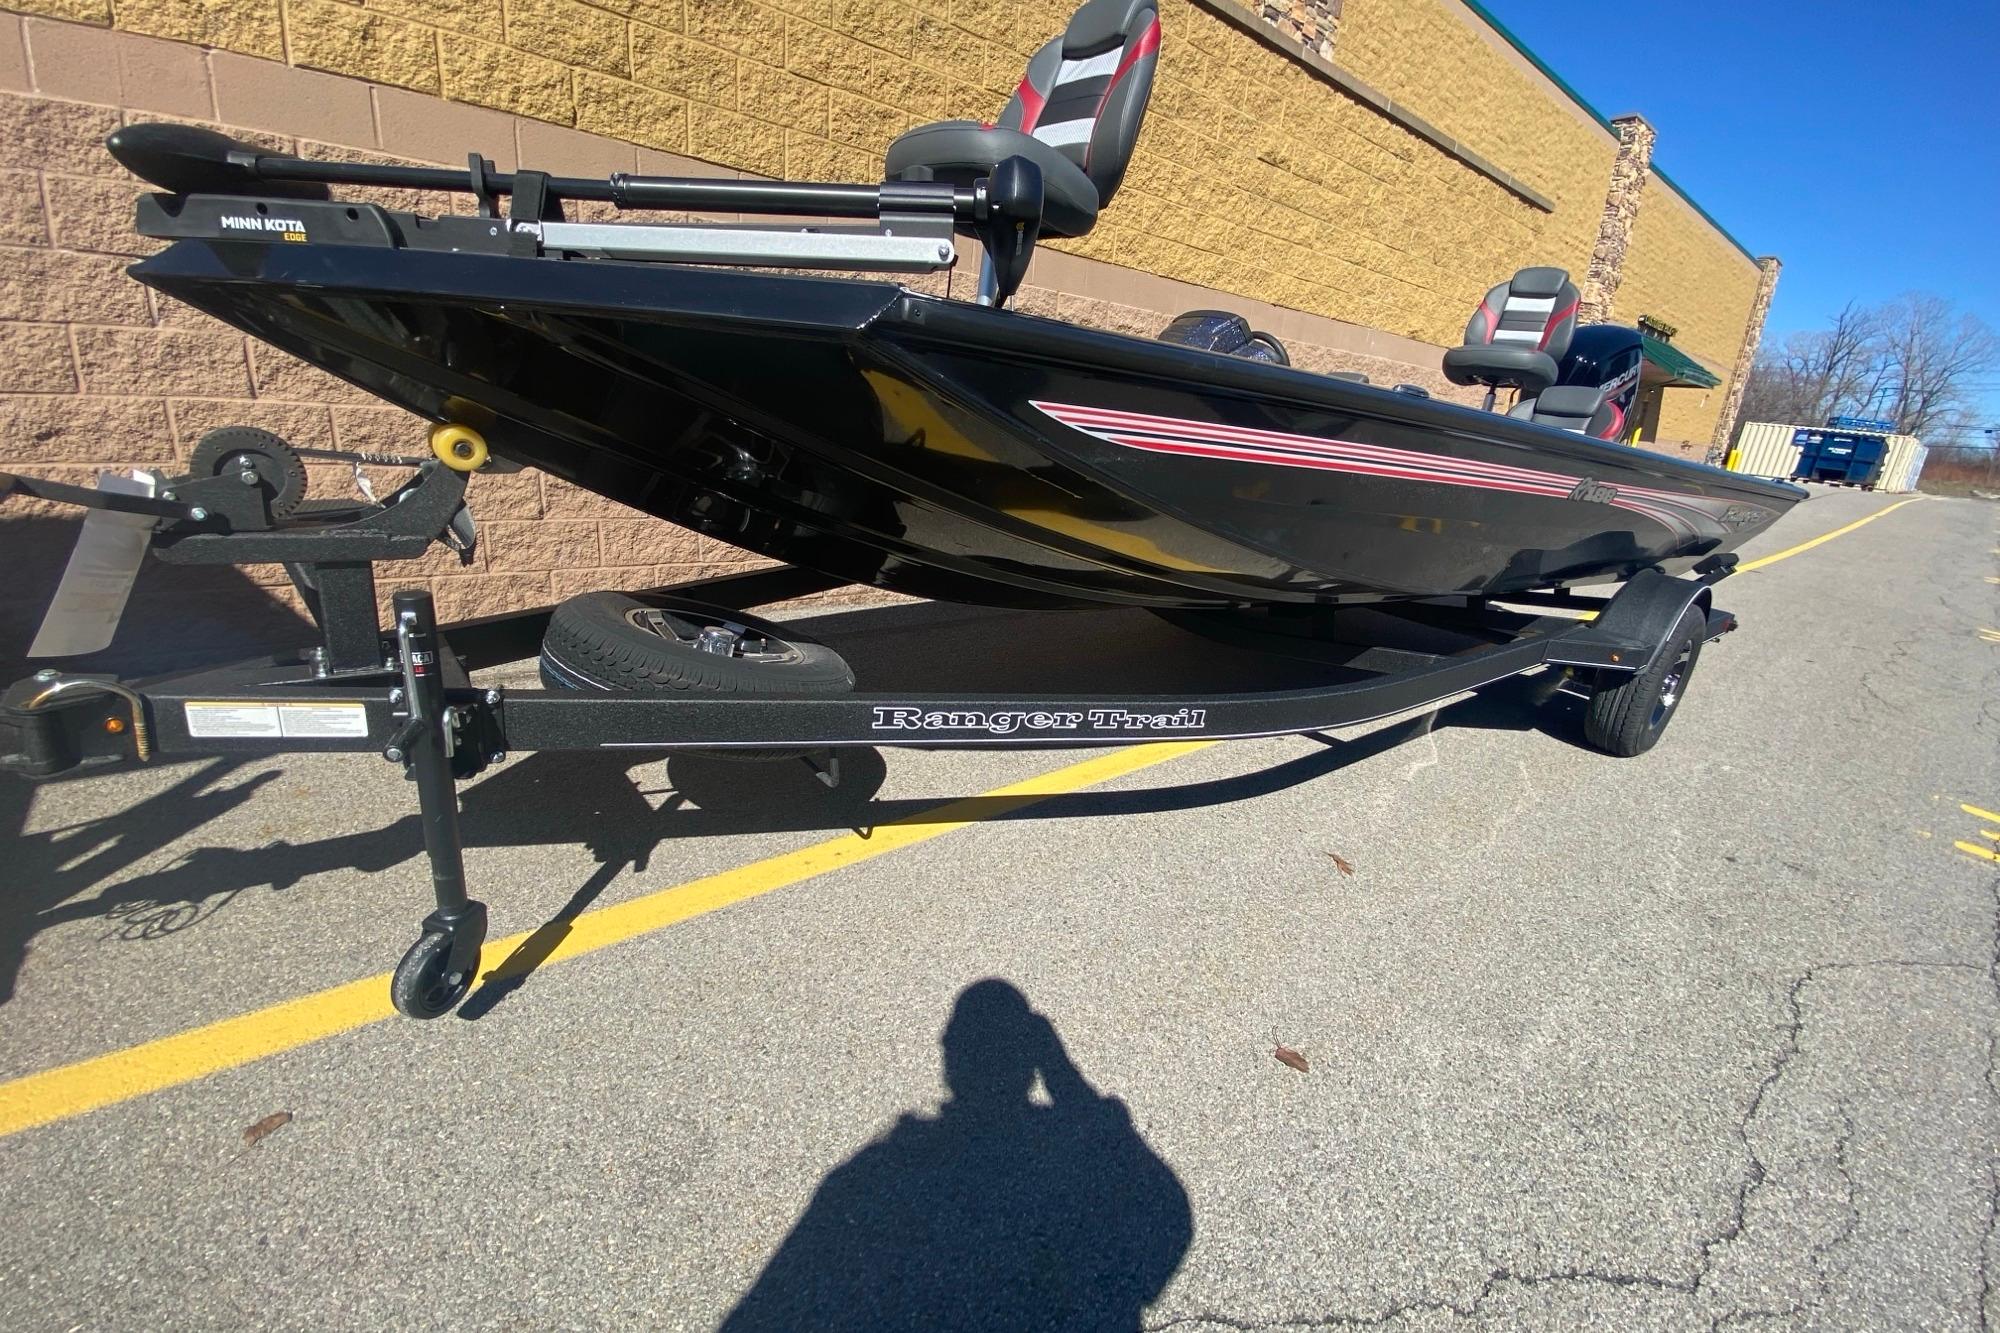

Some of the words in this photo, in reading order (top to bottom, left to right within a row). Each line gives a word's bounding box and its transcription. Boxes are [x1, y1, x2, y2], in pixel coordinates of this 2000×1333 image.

[221, 216, 262, 230] MINN
[264, 218, 306, 232] KOTA
[284, 232, 308, 242] EDGE
[872, 707, 1083, 733] Ranger
[1087, 708, 1206, 729] Trail
